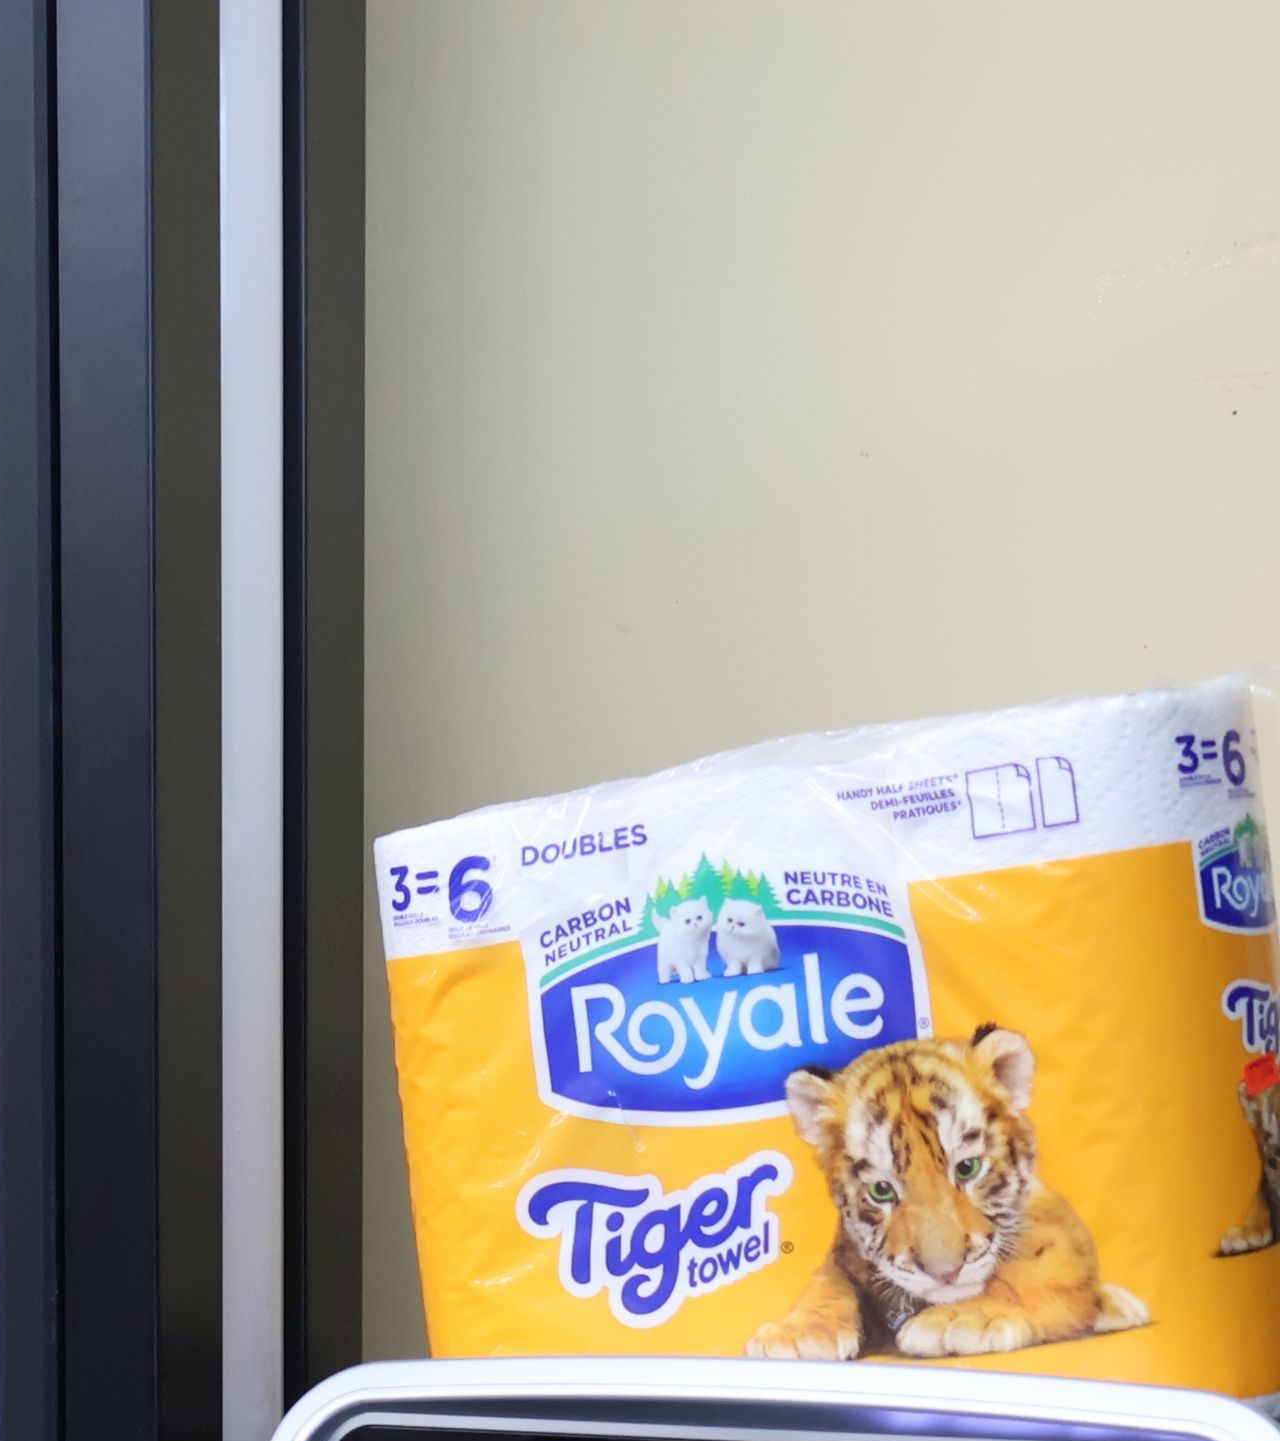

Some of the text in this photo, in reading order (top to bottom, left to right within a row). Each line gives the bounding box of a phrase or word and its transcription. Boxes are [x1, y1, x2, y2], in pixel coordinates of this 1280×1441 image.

[520, 823, 649, 869] DOUBLES
[389, 853, 494, 924] 3=6
[784, 871, 888, 897] NEUTRE EN
[786, 885, 894, 919] CARBONE
[570, 953, 885, 1091] Royale
[527, 1163, 779, 1316] Tiger
[687, 1233, 771, 1290] towel
